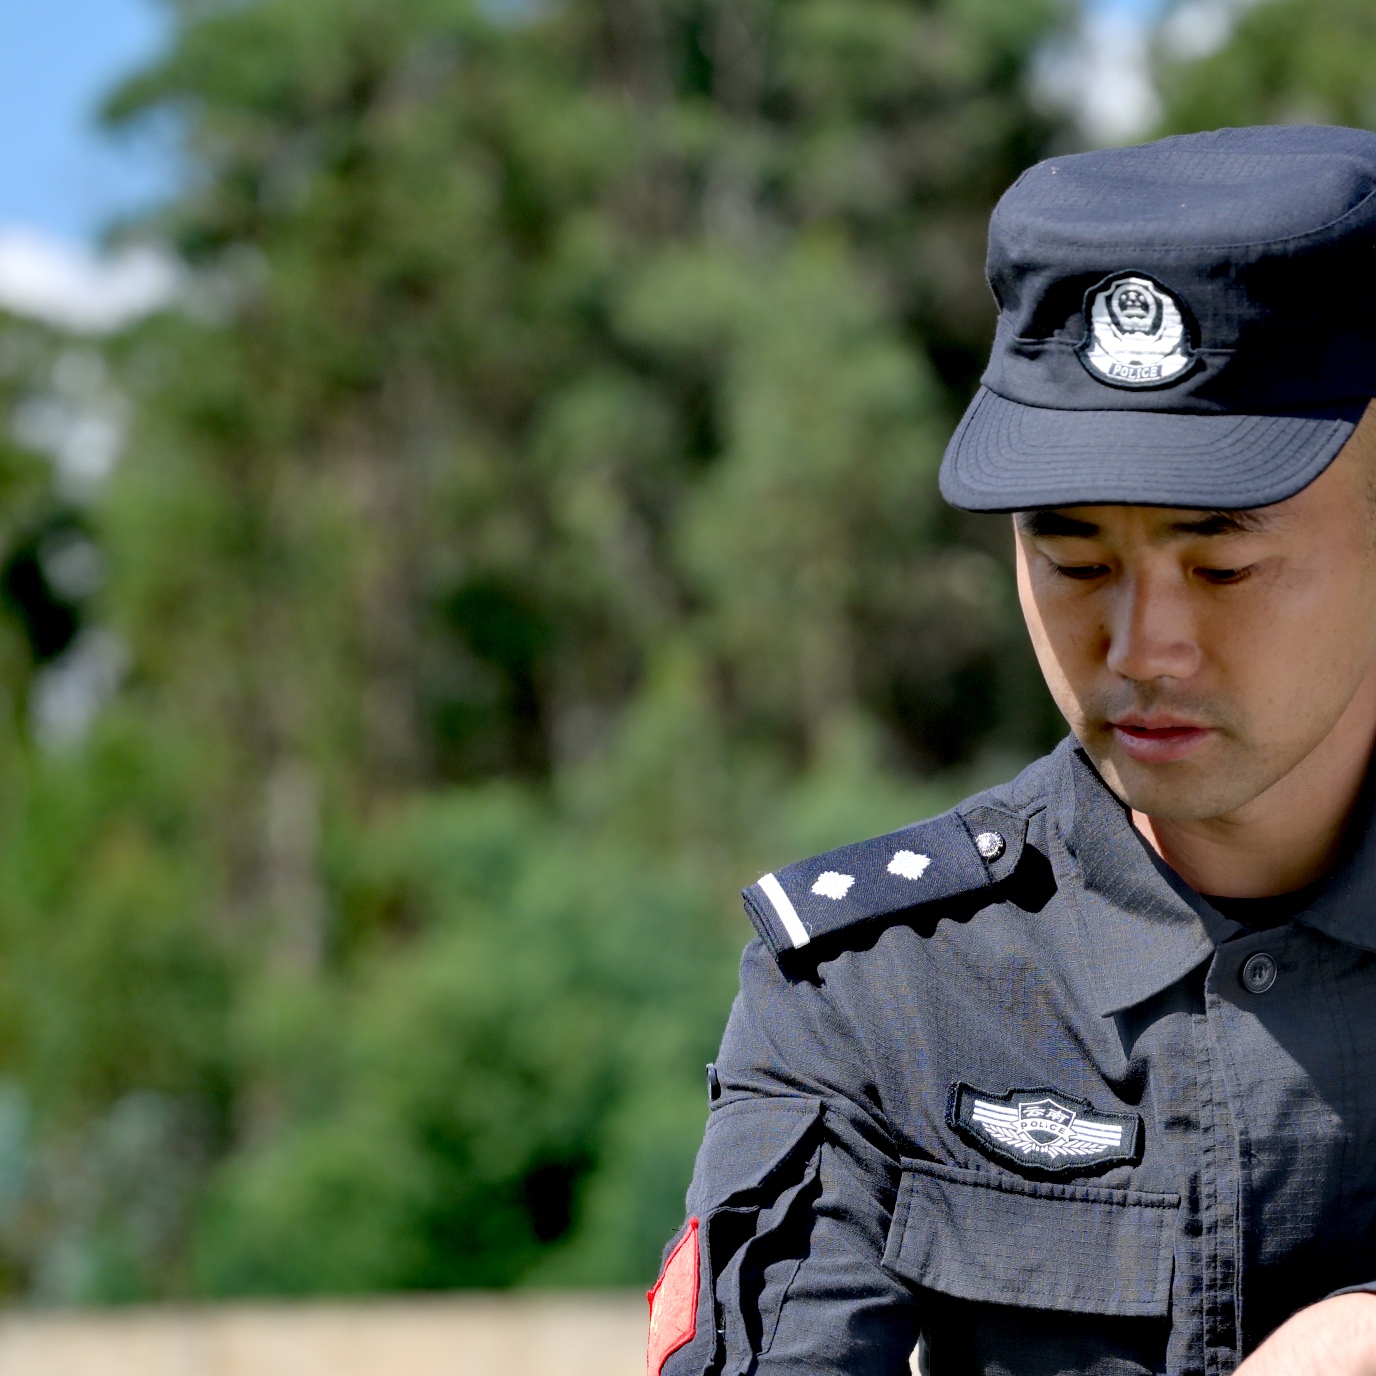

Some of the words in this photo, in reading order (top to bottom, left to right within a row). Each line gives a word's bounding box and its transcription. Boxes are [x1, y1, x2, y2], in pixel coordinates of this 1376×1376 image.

[1112, 364, 1159, 379] POLICE
[1023, 1106, 1071, 1124] 云南
[1021, 1120, 1067, 1135] POLICE
